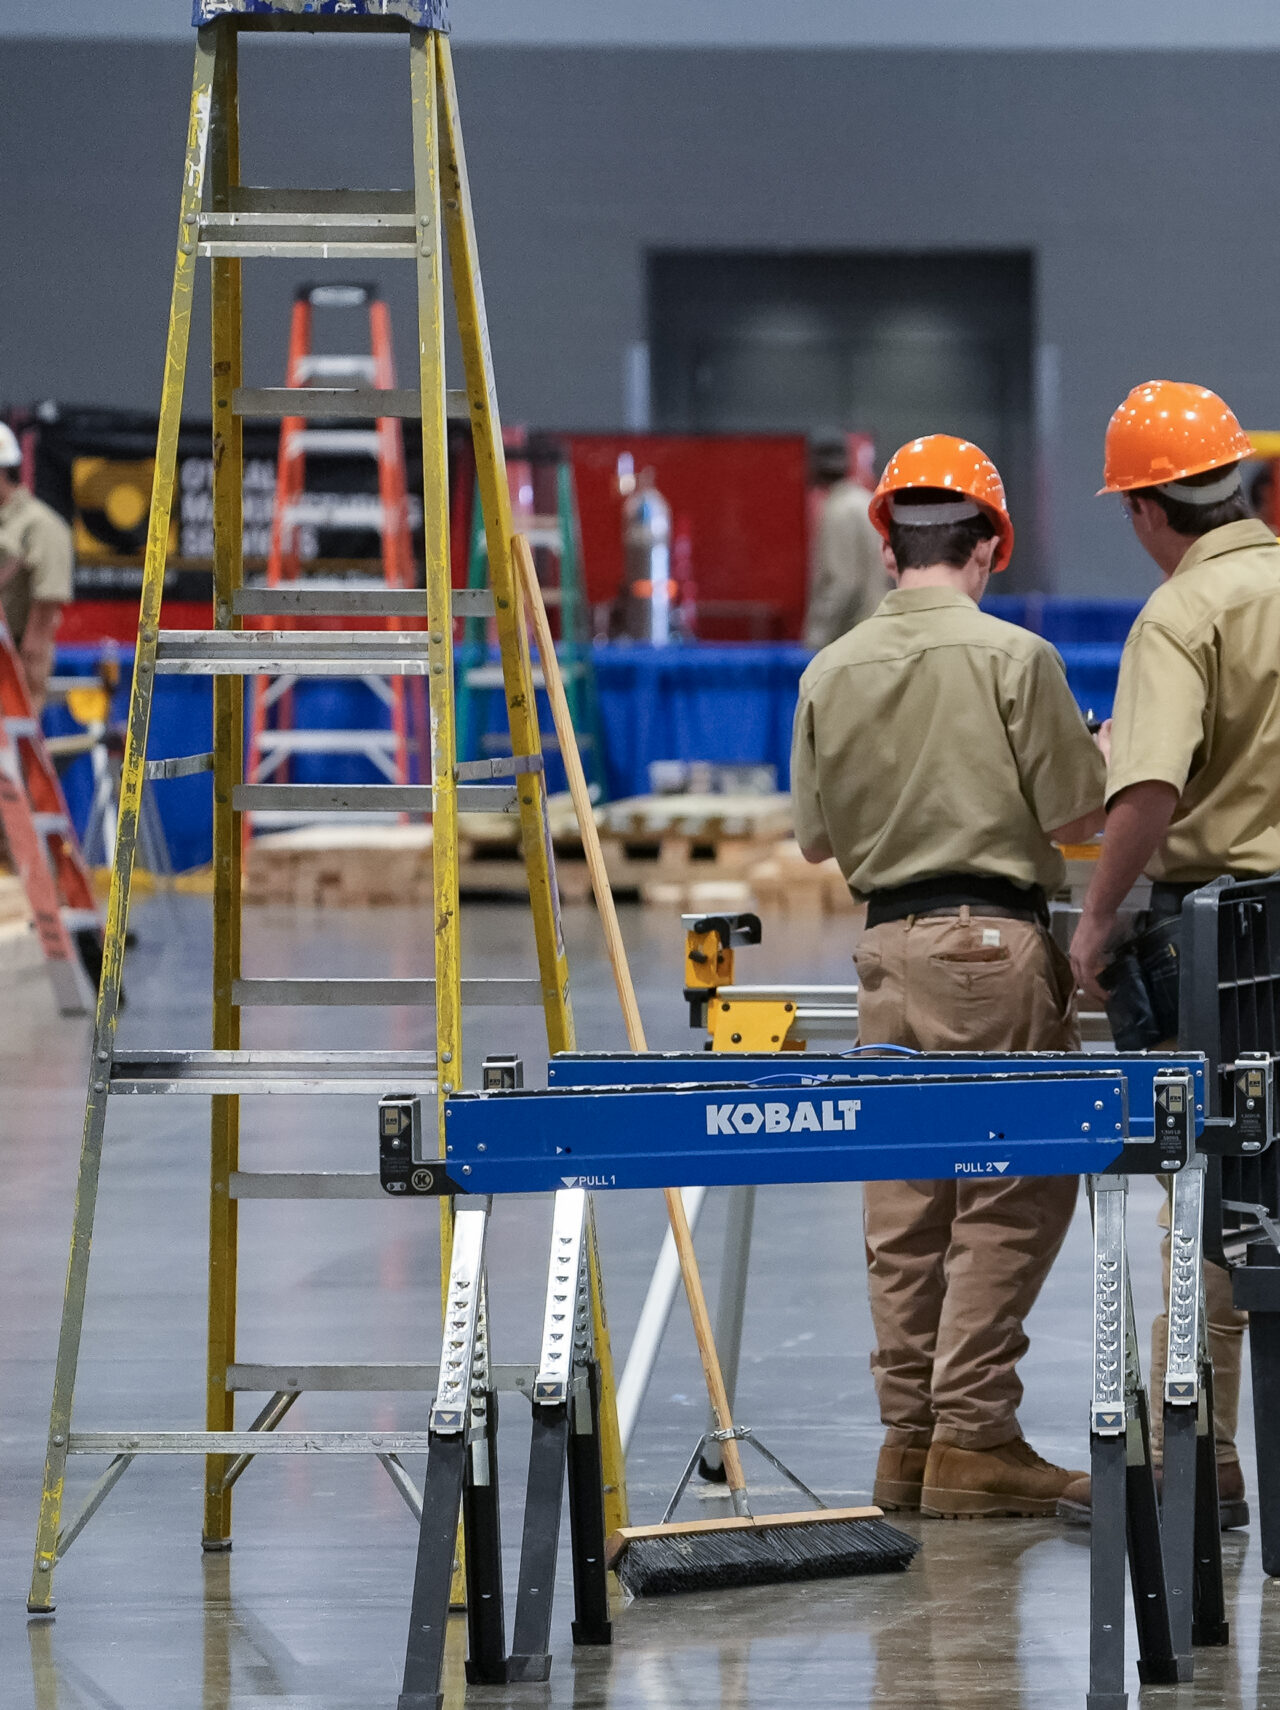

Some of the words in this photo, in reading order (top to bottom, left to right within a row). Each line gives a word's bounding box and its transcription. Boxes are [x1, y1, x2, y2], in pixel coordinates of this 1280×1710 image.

[706, 1099, 861, 1135] KOBALT
[954, 1162, 984, 1173] PULL
[986, 1161, 993, 1172] 2
[578, 1175, 609, 1186] PULL
[610, 1174, 616, 1185] 1
